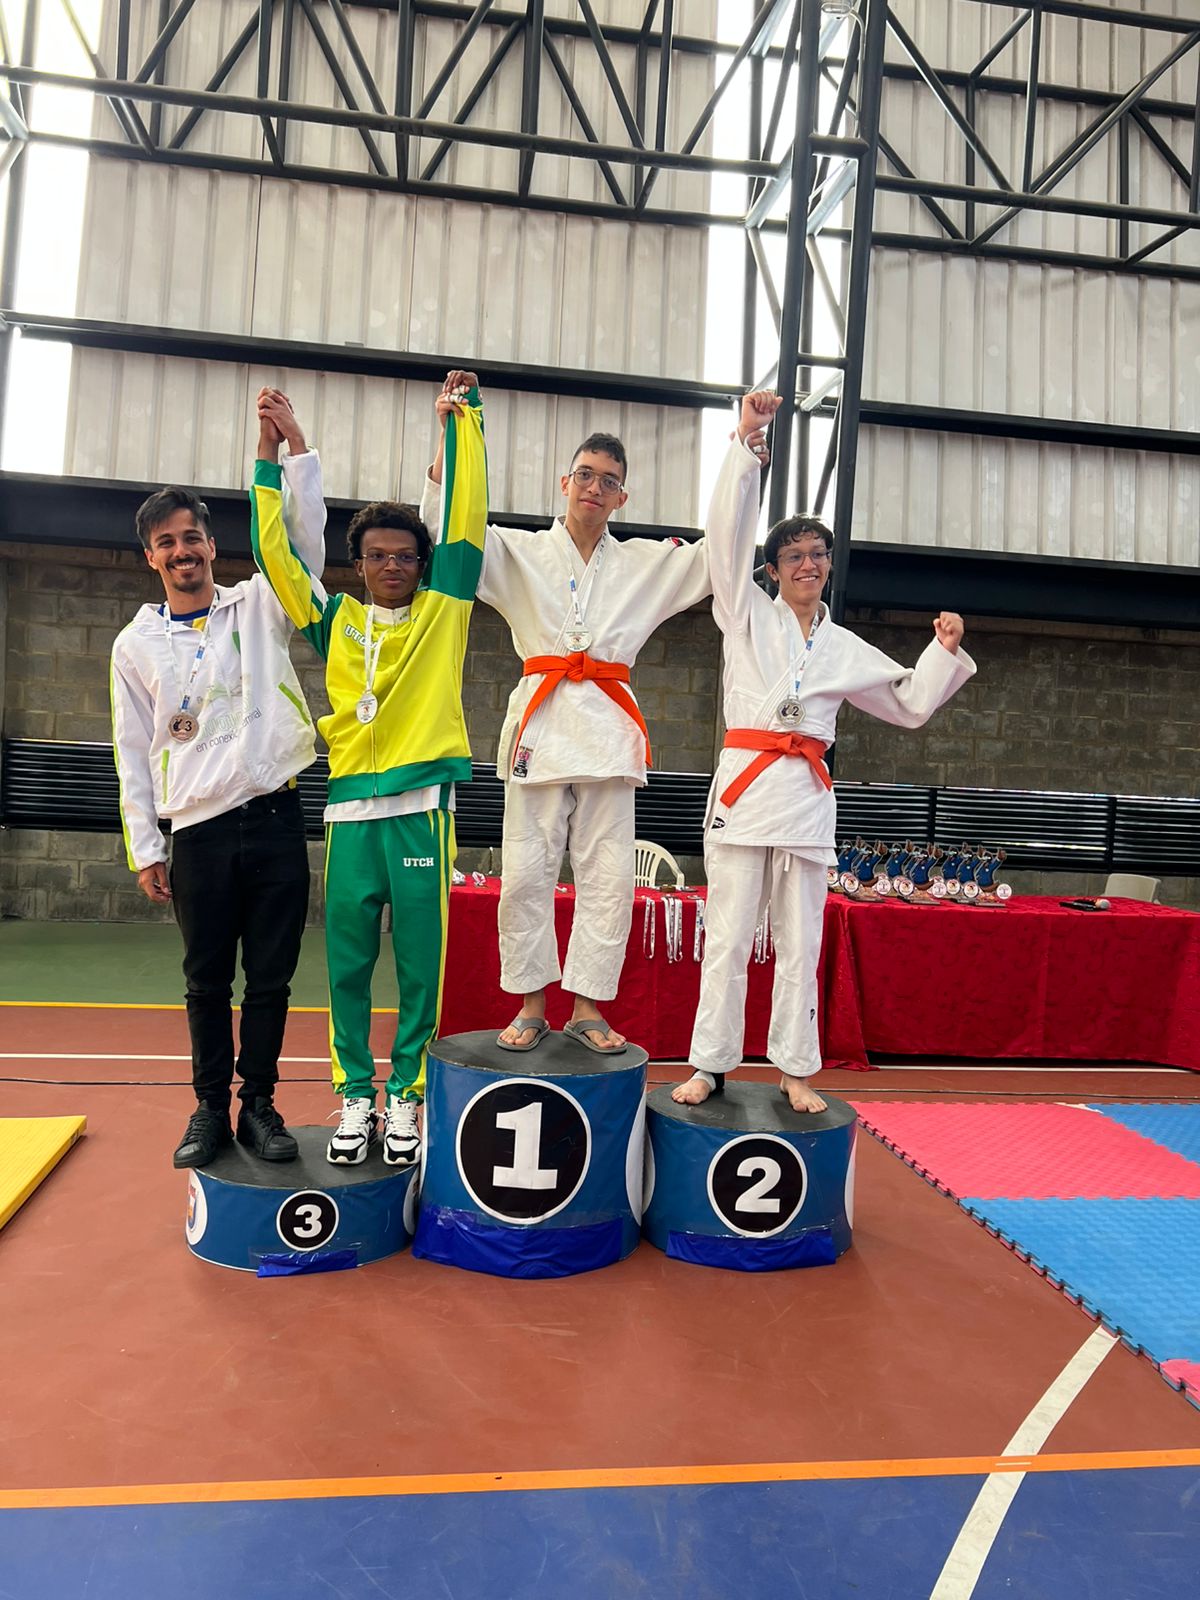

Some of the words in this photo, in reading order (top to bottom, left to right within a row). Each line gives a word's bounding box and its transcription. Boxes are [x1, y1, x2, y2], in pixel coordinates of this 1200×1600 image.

[792, 705, 800, 717] 2
[184, 720, 193, 732] 3
[195, 741, 208, 753] en
[403, 857, 435, 868] UTCH
[492, 1102, 558, 1190] 1
[734, 1156, 782, 1213] 2
[293, 1204, 323, 1238] 3
